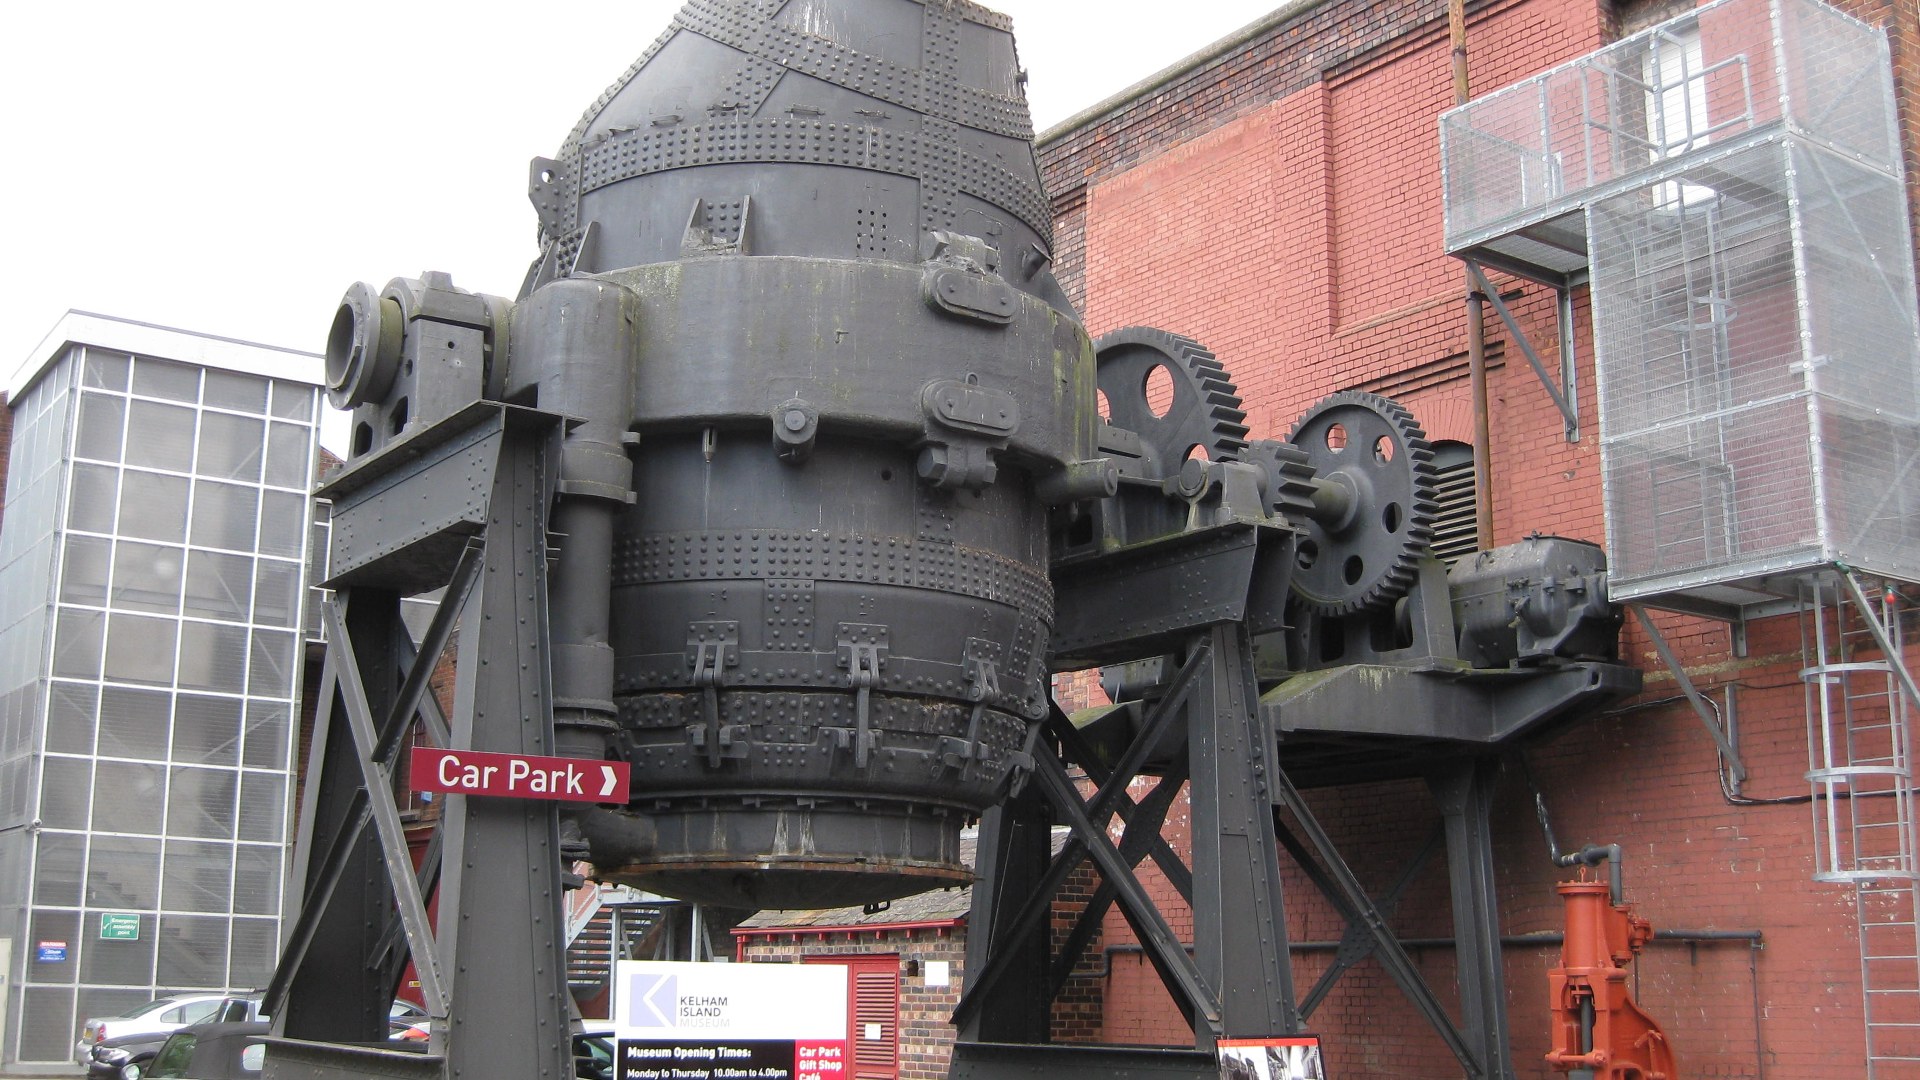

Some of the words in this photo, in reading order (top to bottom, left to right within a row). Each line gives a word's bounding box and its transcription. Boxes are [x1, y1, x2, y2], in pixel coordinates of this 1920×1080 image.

[439, 755, 498, 789] Car
[508, 759, 584, 795] Park
[680, 996, 728, 1006] KELHAM
[680, 1007, 721, 1017] ISLAND
[680, 1018, 730, 1028] MUSEUM
[627, 1046, 672, 1058] Museum
[673, 1047, 715, 1060] Opening
[717, 1047, 752, 1058] Times:
[799, 1046, 817, 1057] Car
[818, 1047, 842, 1057] Park
[799, 1060, 817, 1070] Gift
[818, 1060, 843, 1072] Shop
[627, 1068, 660, 1080] Monday
[661, 1068, 670, 1078] to
[671, 1068, 710, 1080] Thursday
[714, 1068, 747, 1077] 10.00am
[748, 1068, 757, 1077] to
[758, 1068, 788, 1079] 4.00pm
